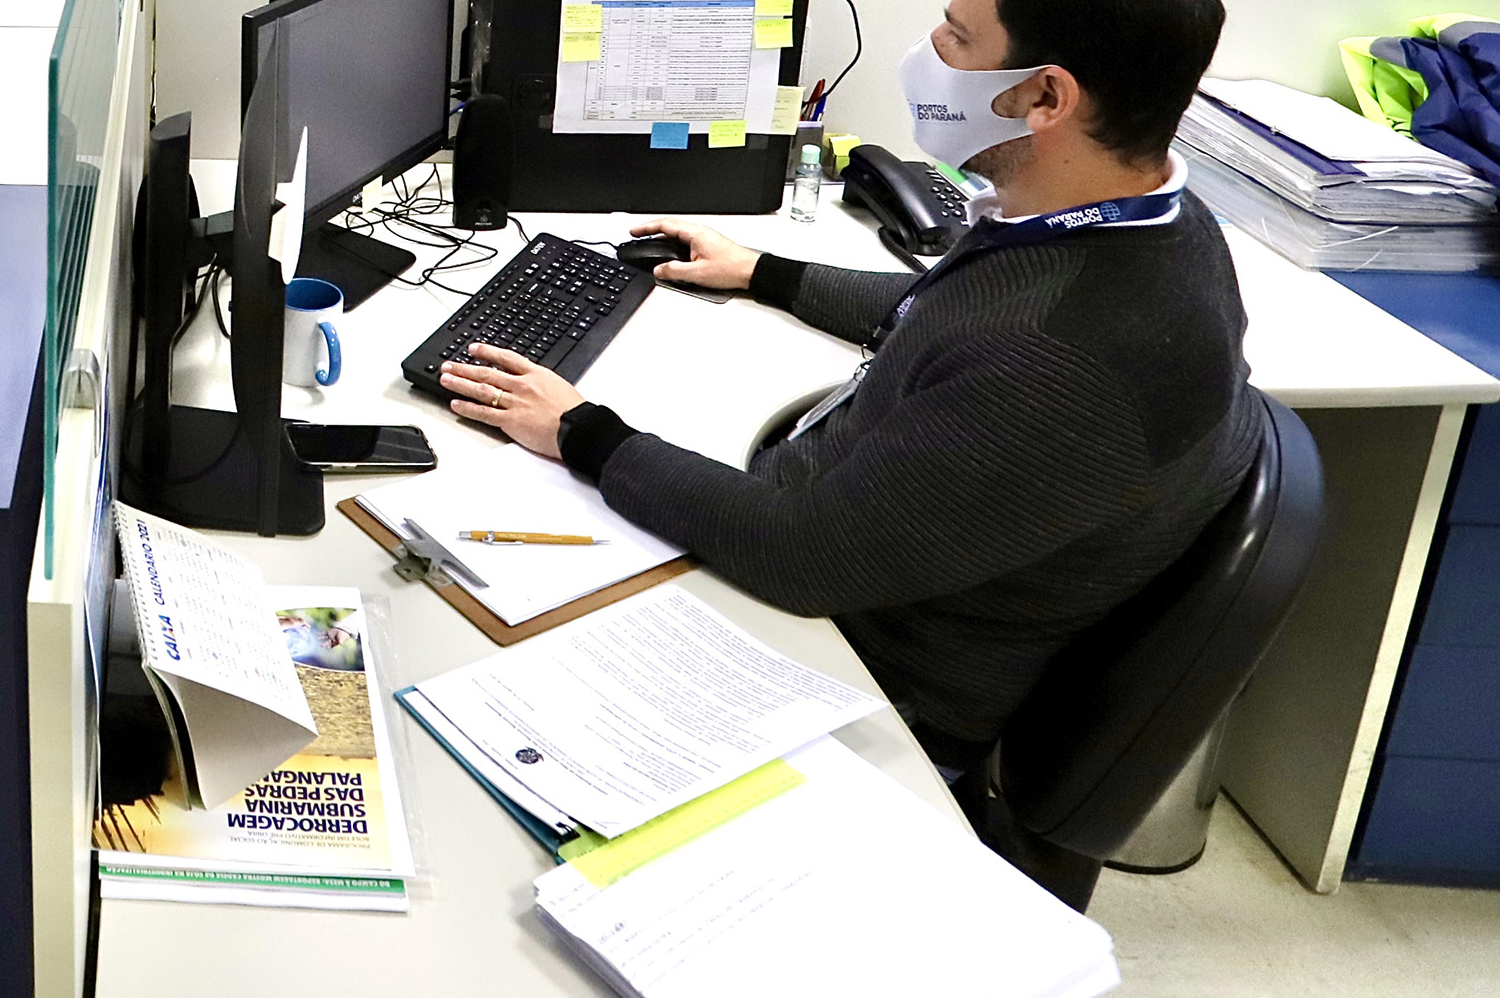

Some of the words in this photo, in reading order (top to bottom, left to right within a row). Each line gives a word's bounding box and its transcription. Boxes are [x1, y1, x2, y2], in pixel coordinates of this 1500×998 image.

[916, 103, 948, 113] PORTOS
[917, 112, 930, 120] DO
[931, 110, 967, 121] PARANÁ
[1084, 207, 1101, 216] DO
[1044, 210, 1084, 229] PARANÁ
[1064, 214, 1104, 229] PORTOS
[136, 518, 151, 542] 2021
[157, 613, 181, 662] CAIXA
[244, 783, 320, 801] PEDRAS
[324, 786, 364, 802] DAS
[244, 798, 366, 818] SUBMARINA
[227, 813, 368, 835] DERROCAGEM
[229, 835, 256, 843] SOCIAL
[284, 832, 336, 842] INFORMATIVO
[256, 838, 315, 848] COMUNICAÇÃO
[327, 841, 371, 849] PROGRAMA
[273, 875, 321, 884] REPORTAGEM
[351, 879, 378, 887] CAMPO
[379, 880, 391, 888] DO
